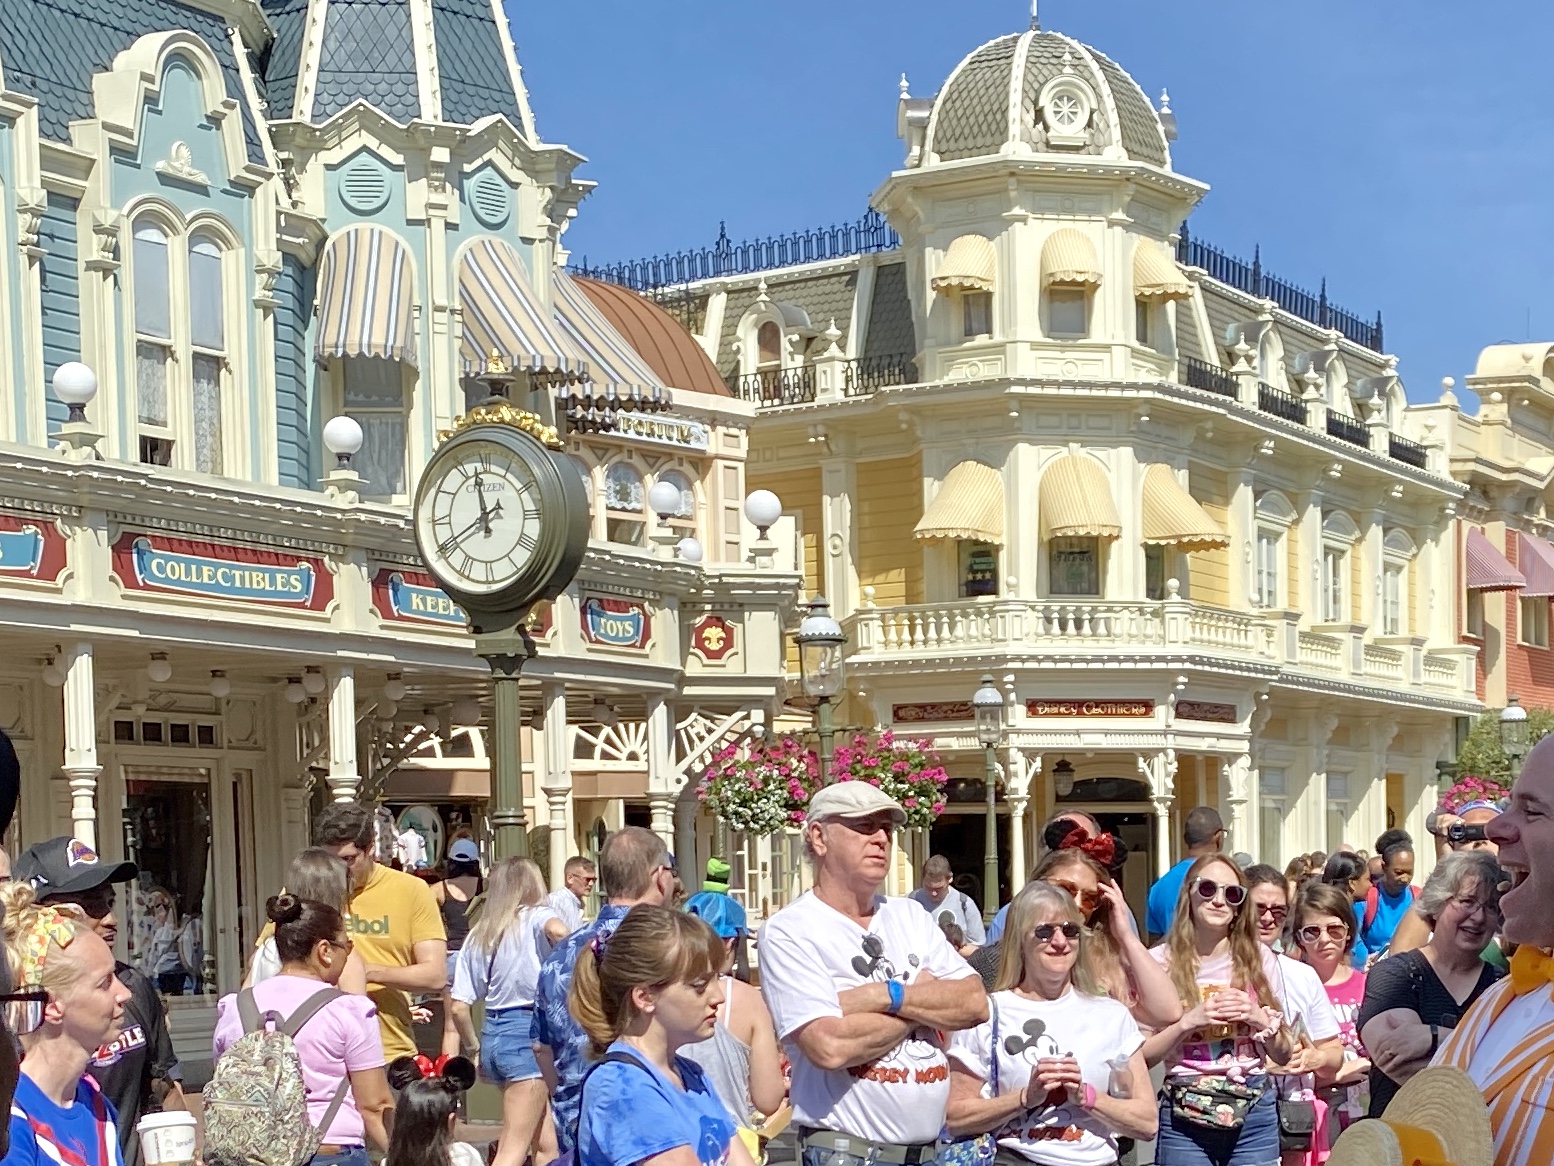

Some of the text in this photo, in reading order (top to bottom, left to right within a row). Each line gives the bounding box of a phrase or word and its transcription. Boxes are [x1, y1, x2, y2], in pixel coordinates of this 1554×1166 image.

[620, 416, 693, 444] PORIUM
[466, 482, 506, 493] CIIZEN
[151, 557, 303, 593] COLLECTIBLES
[600, 617, 634, 638] TOYS
